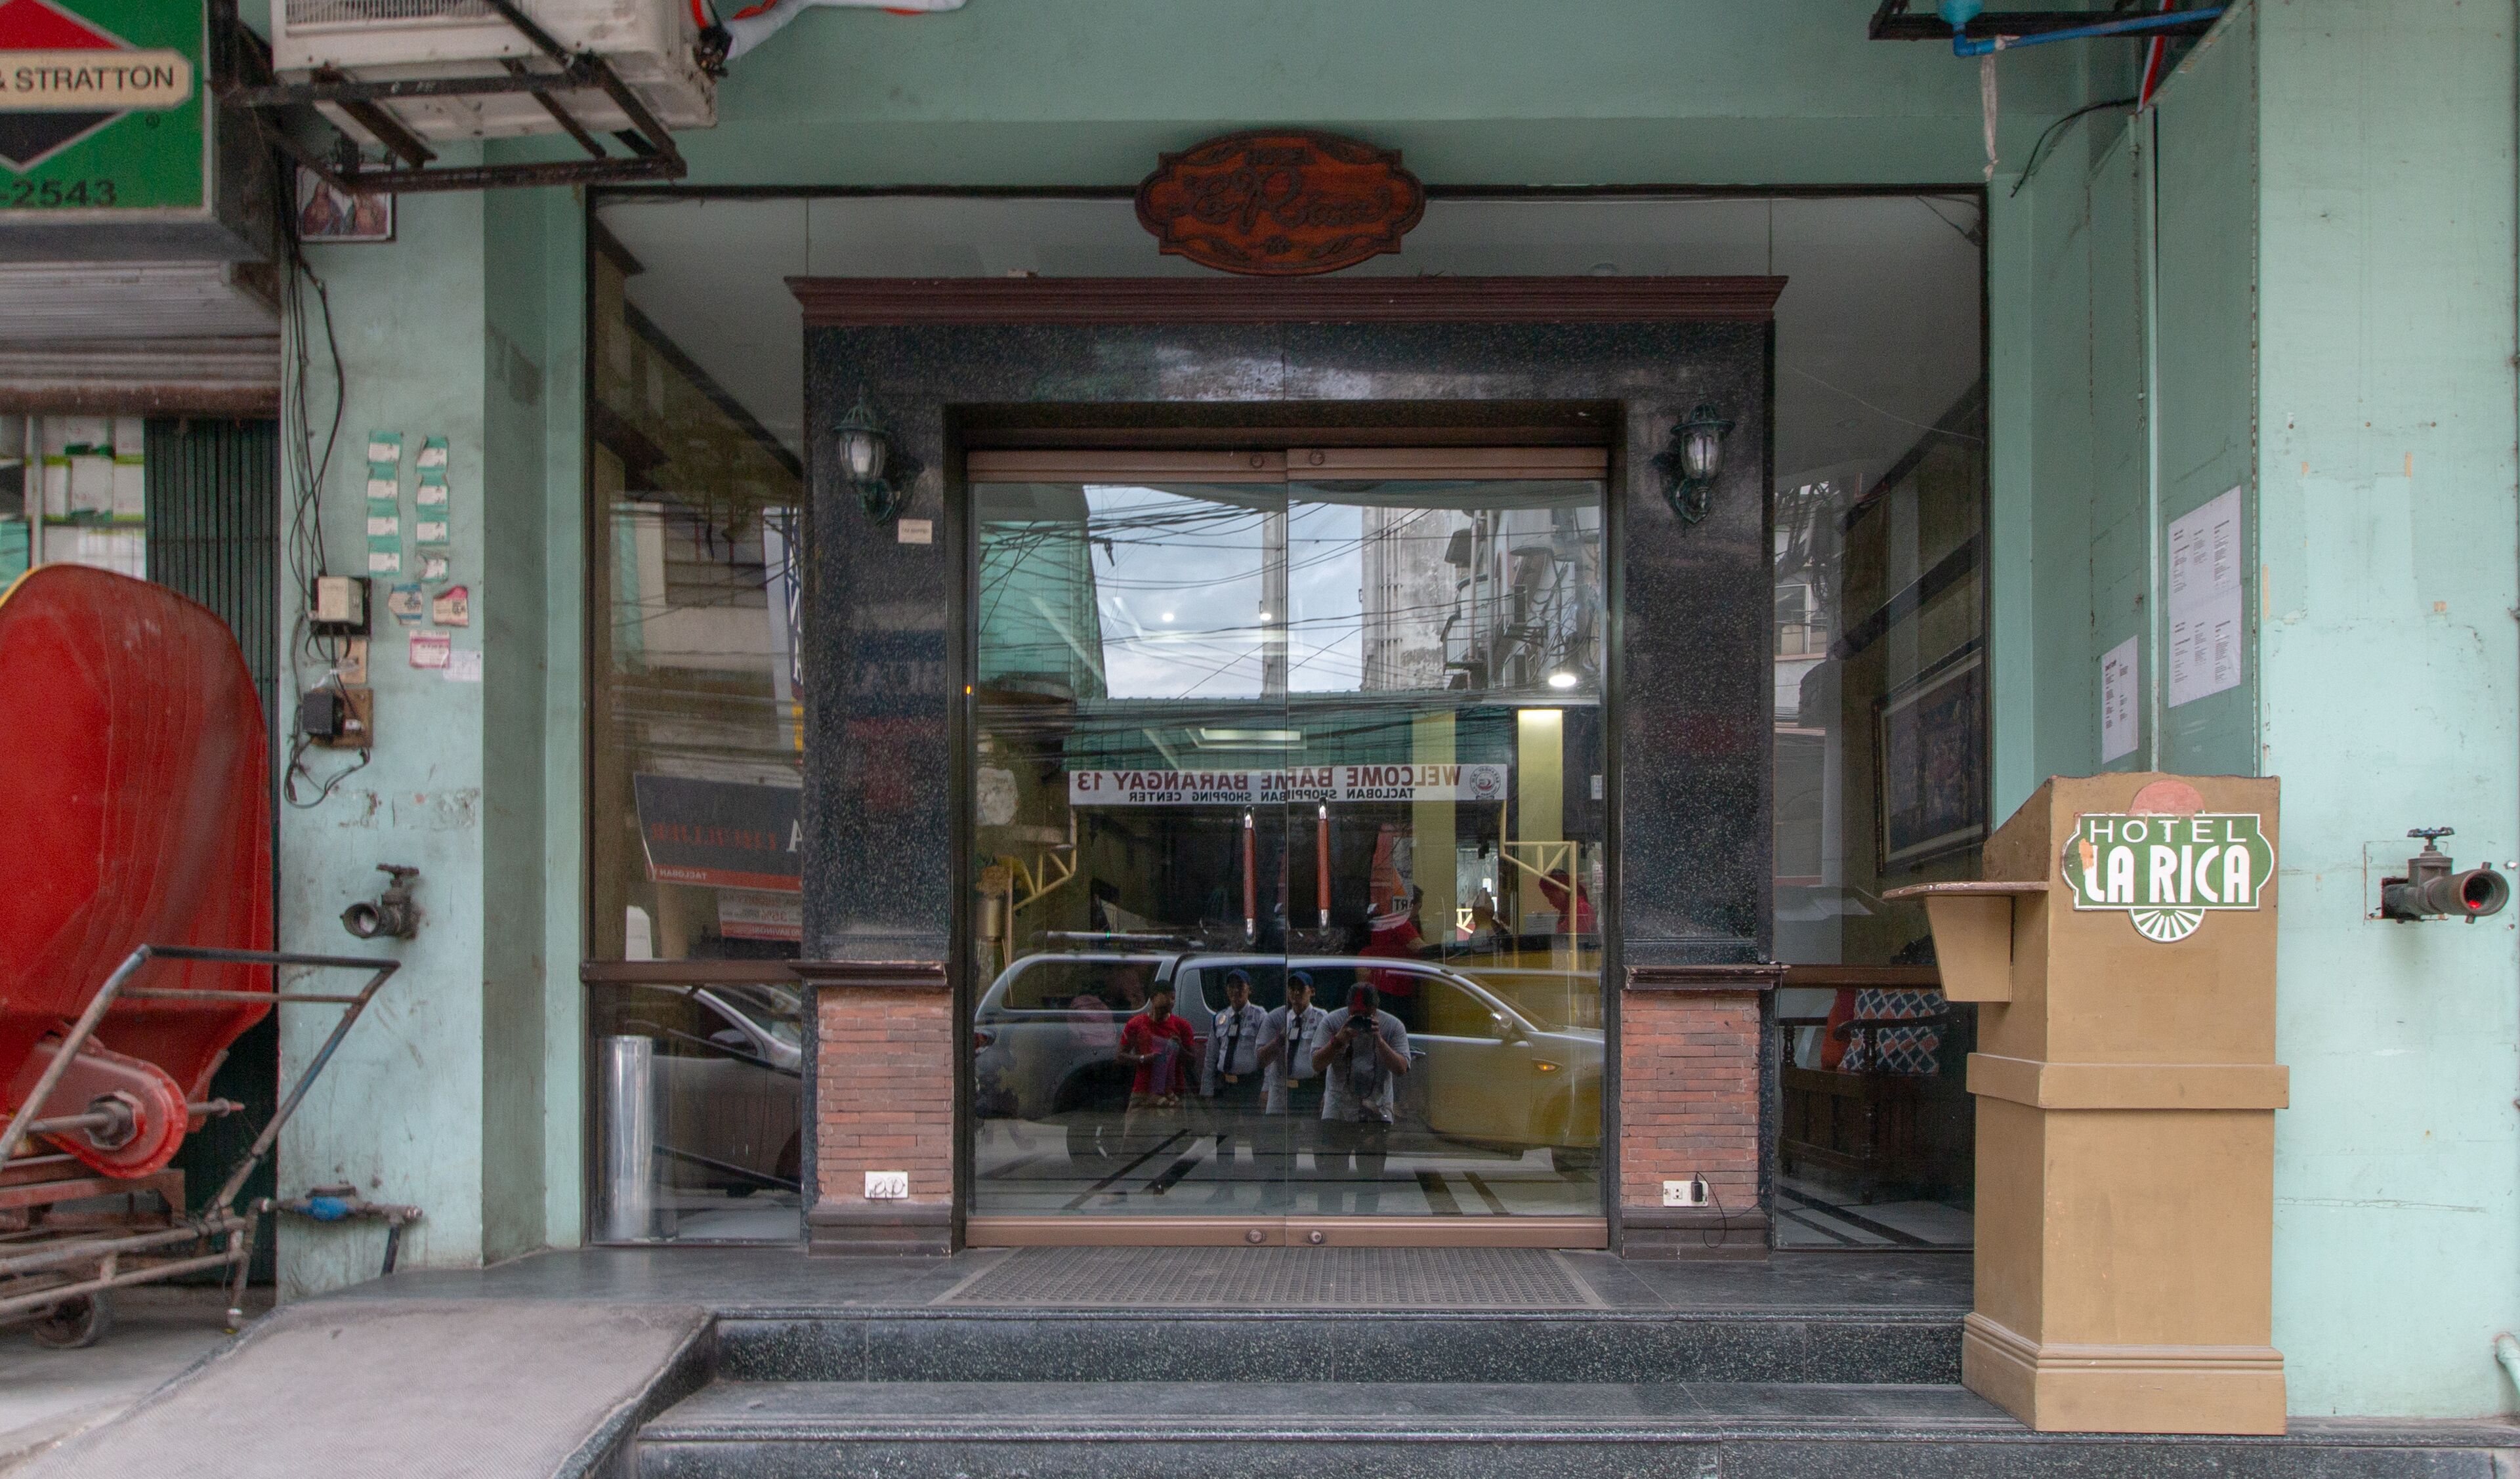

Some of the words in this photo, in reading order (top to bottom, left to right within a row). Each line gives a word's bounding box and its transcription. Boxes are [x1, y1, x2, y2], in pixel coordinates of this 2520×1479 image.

[15, 66, 174, 91] STRATTON
[2090, 820, 2247, 843] HOTEL
[2084, 844, 2135, 904] LA
[2149, 844, 2250, 904] RICA
